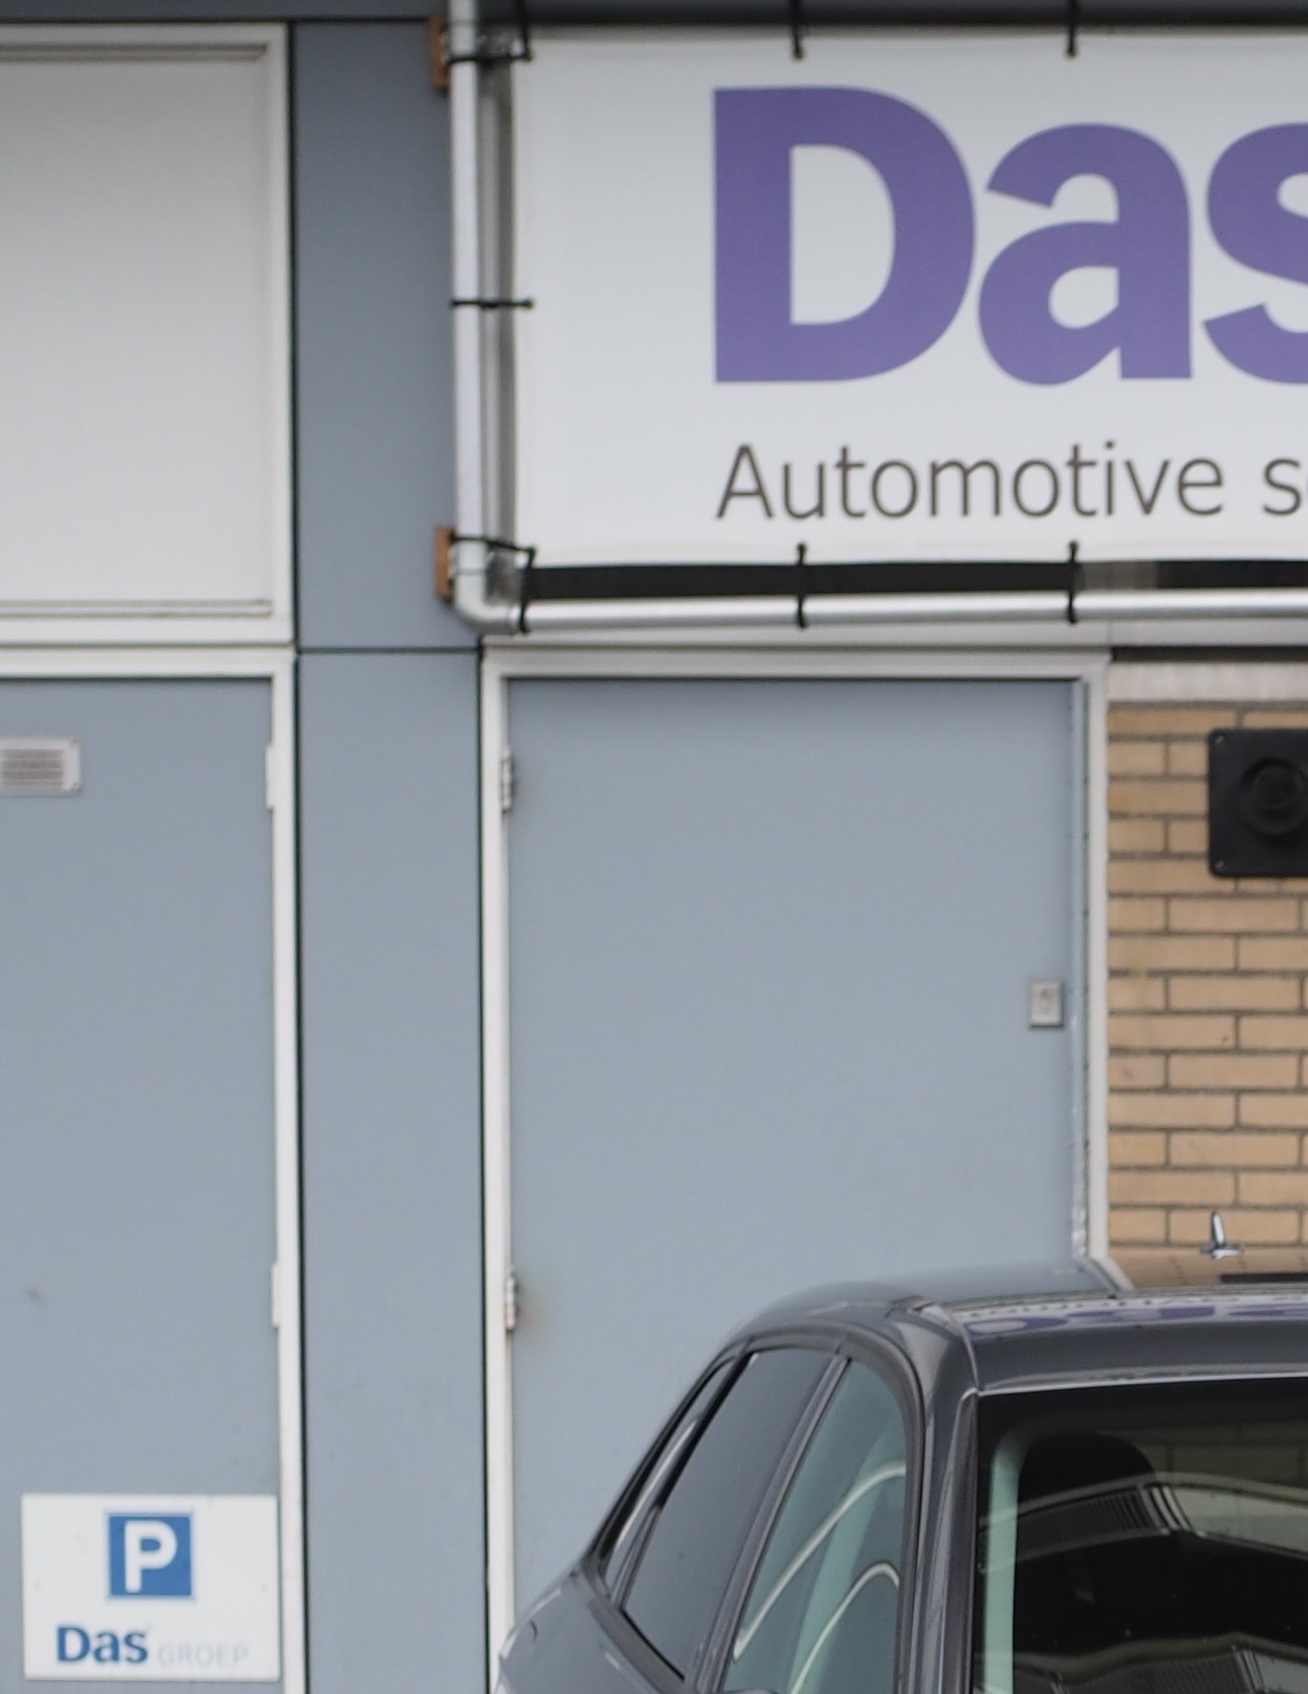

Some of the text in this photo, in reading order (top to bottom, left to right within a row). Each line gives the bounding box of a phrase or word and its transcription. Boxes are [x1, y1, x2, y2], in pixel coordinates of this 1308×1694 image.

[715, 439, 1225, 522] Automotive
[123, 1518, 178, 1594] P
[56, 1625, 250, 1668] Das GROEP
